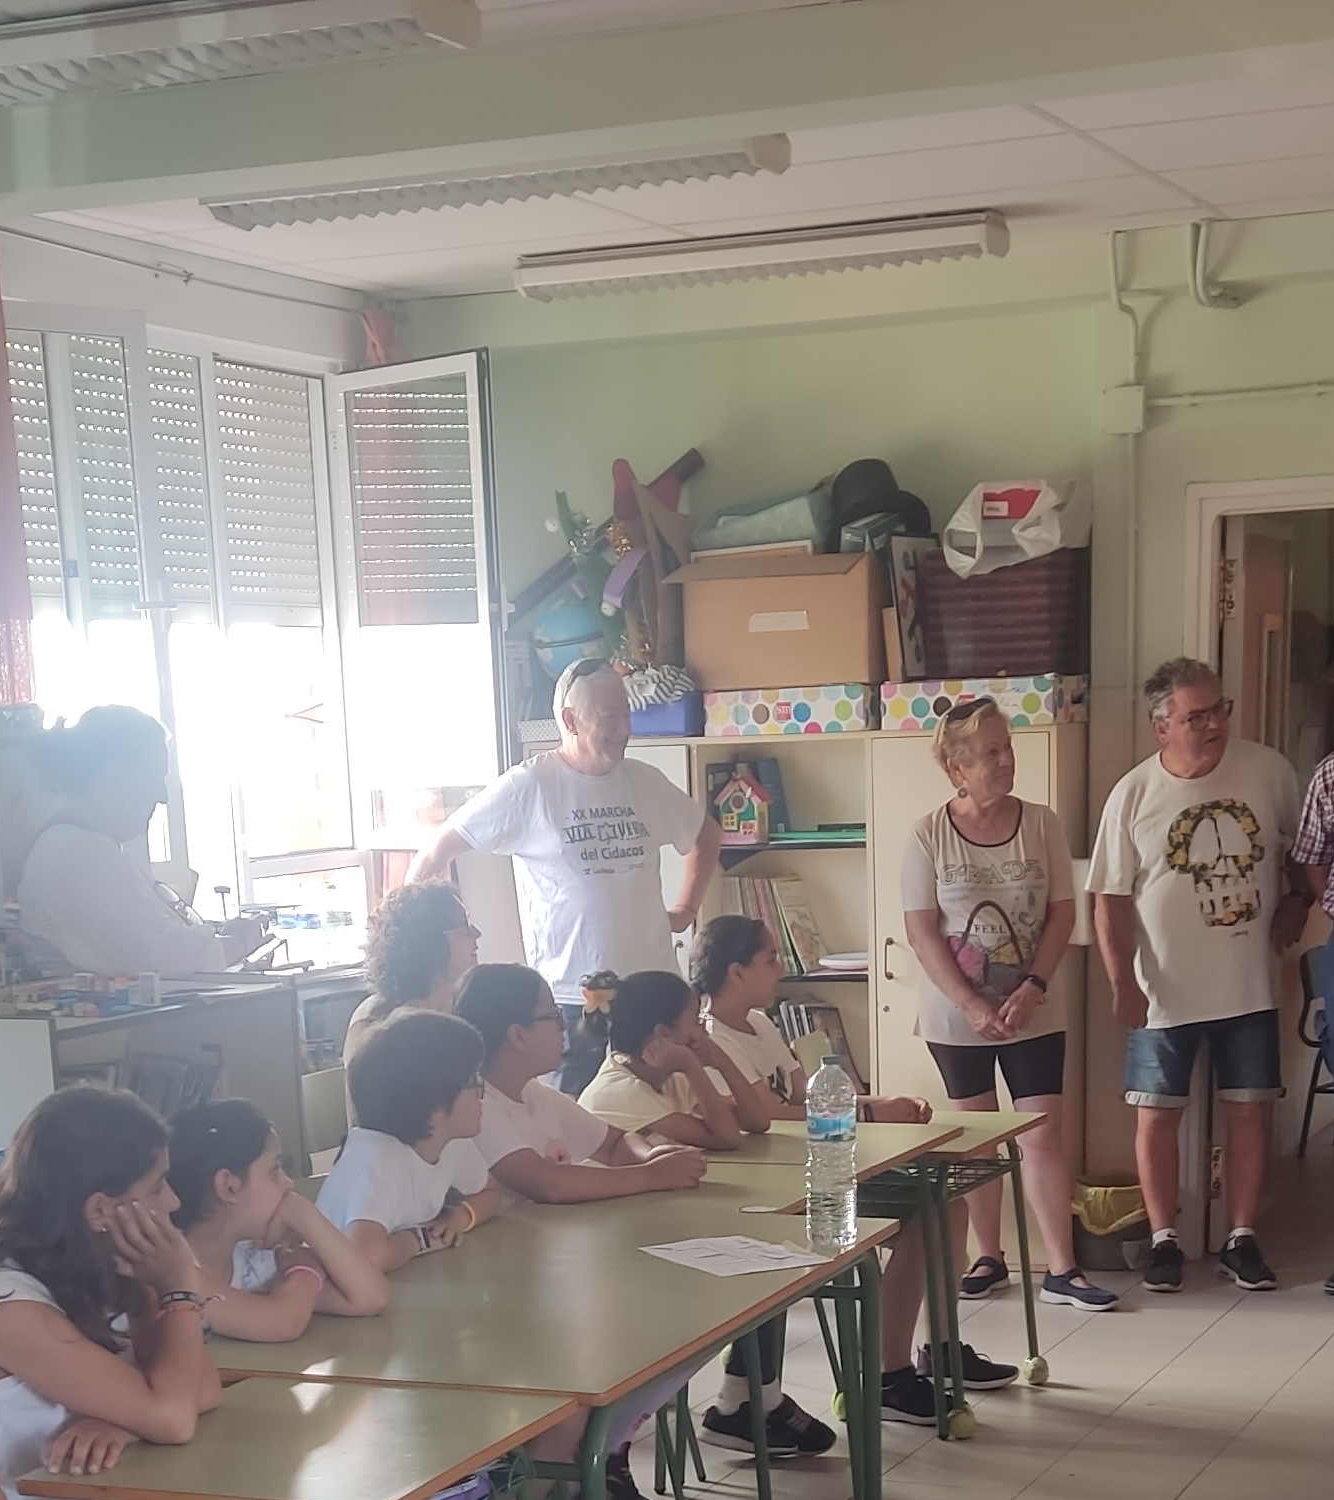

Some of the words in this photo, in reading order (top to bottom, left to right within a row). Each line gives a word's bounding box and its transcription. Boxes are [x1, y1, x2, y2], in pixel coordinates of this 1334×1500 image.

[571, 808, 588, 820] XX
[589, 806, 636, 819] MARCHA
[580, 847, 599, 861] del
[600, 845, 645, 860] Cidacos
[974, 924, 1007, 934] FEEL
